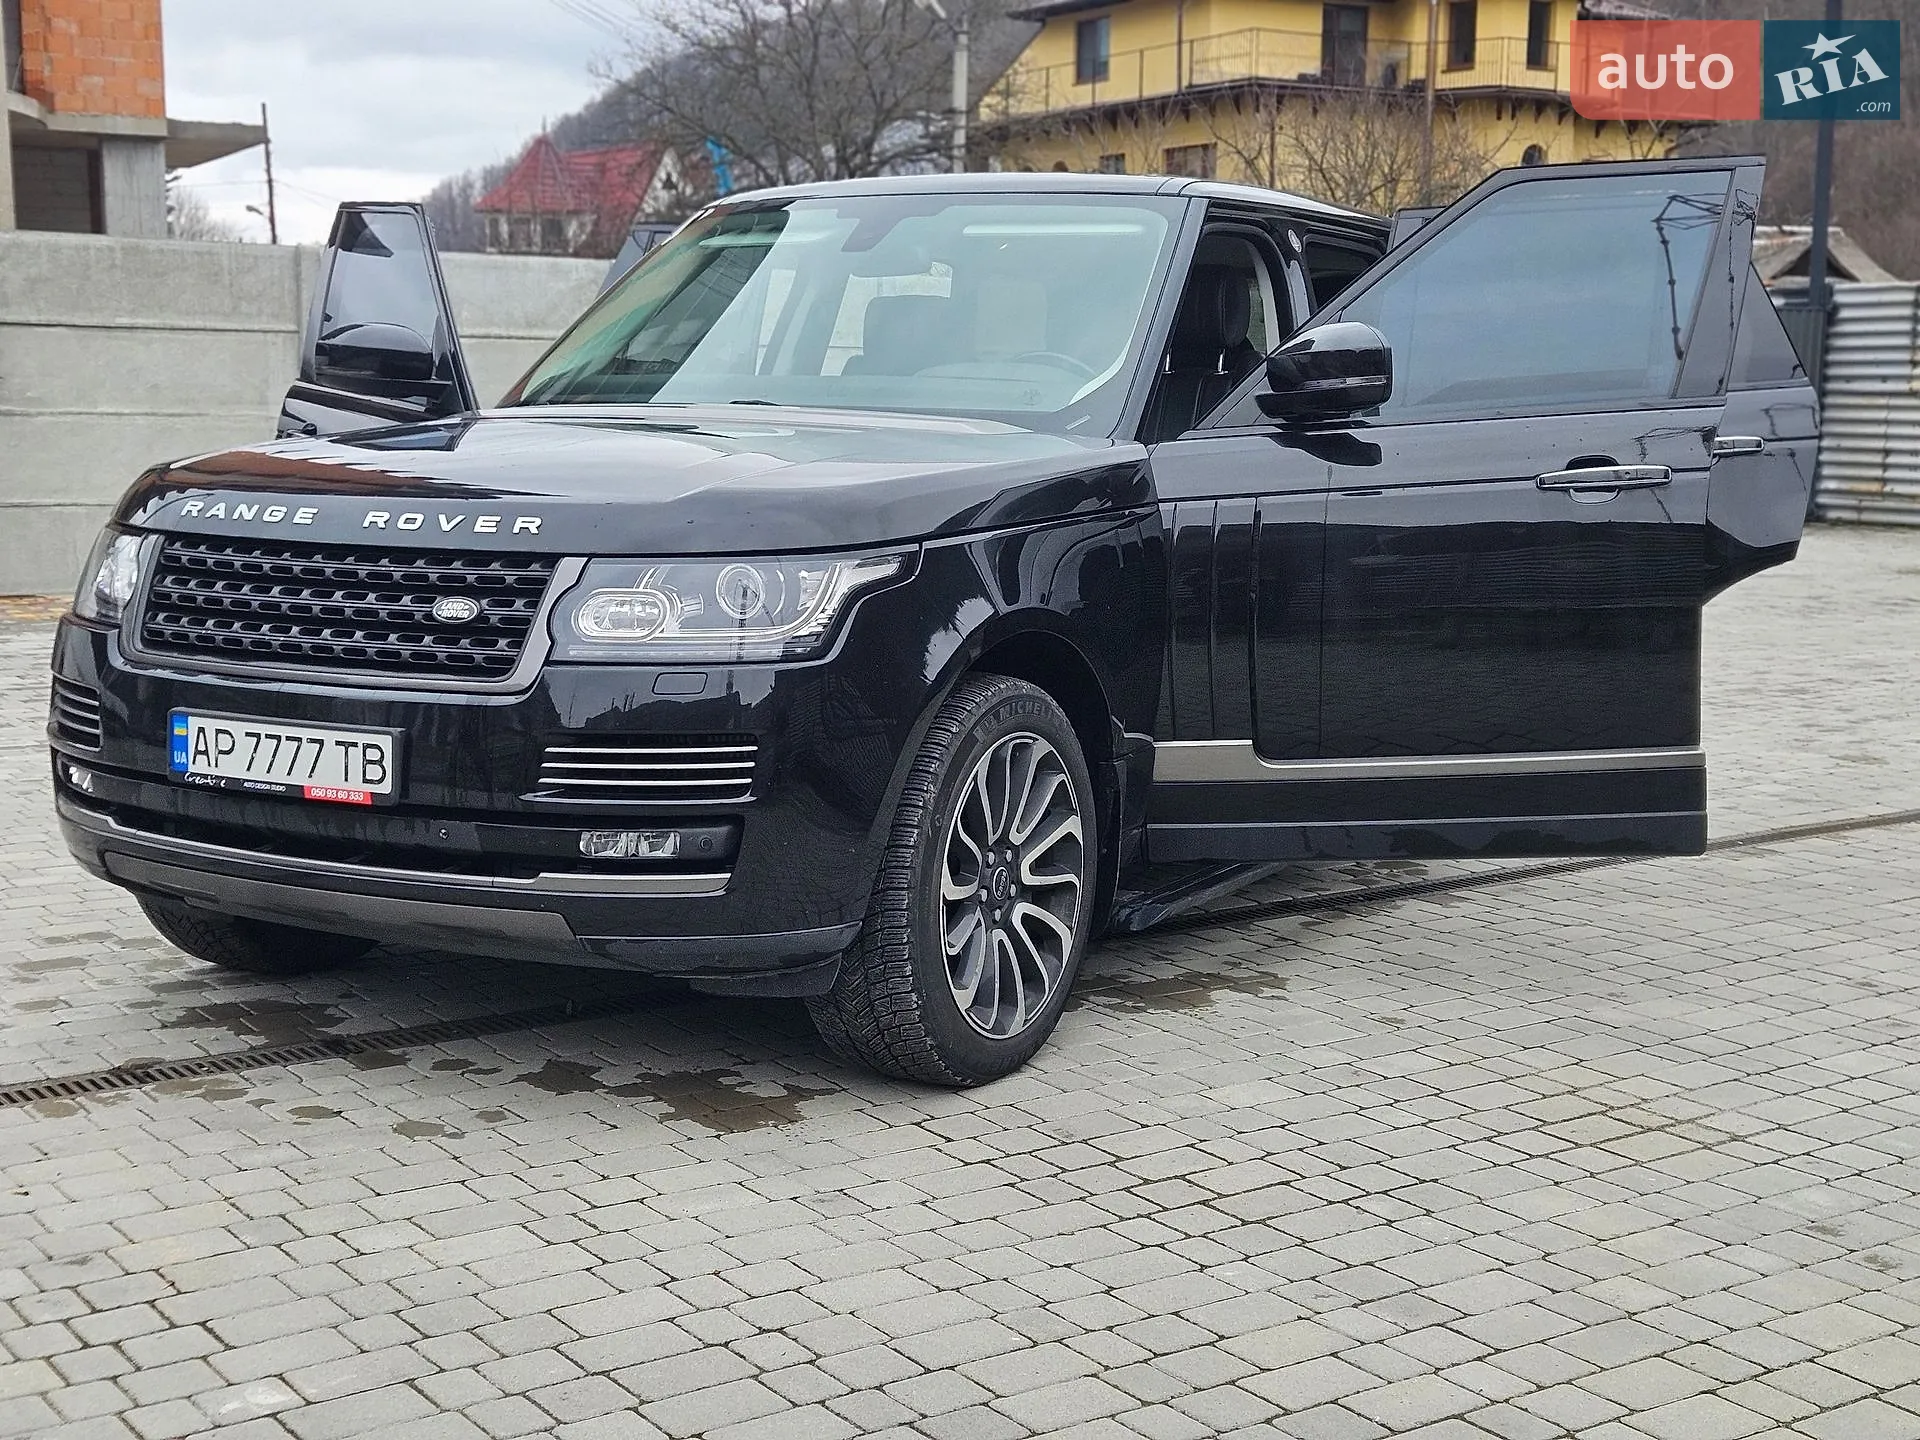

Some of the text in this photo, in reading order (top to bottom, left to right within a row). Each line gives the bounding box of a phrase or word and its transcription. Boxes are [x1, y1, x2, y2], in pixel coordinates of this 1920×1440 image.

[180, 500, 542, 535] RANGE ROVER
[441, 602, 464, 610] LAND
[441, 609, 470, 619] ROVER
[174, 750, 187, 764] UA
[191, 726, 388, 786] AP 7777 TB
[310, 787, 364, 801] 050 93 60 333
